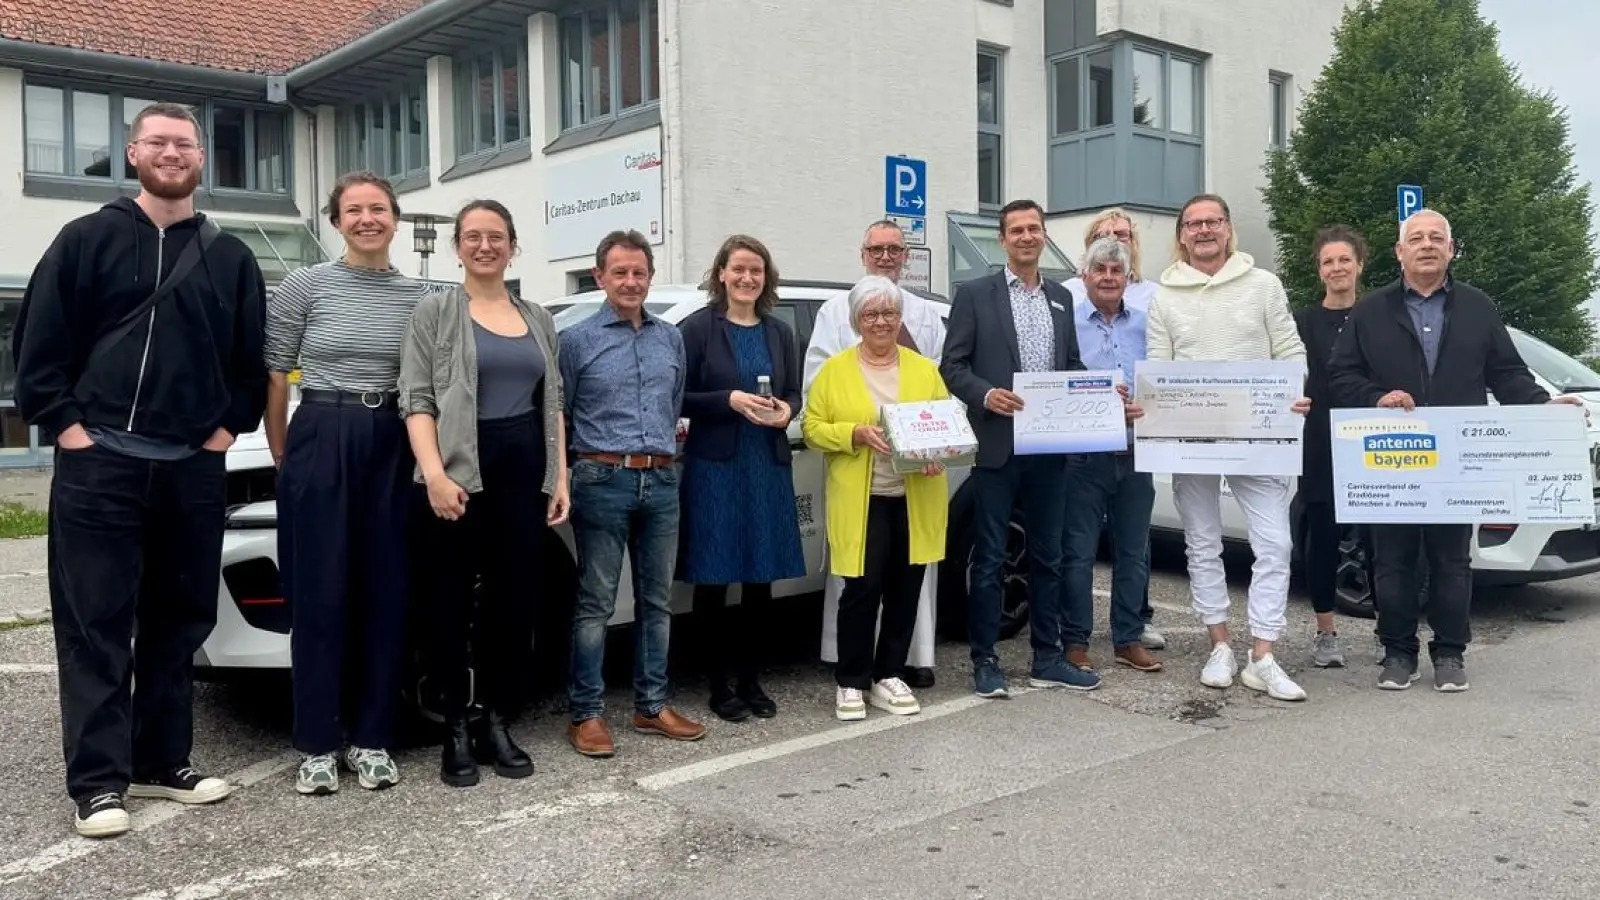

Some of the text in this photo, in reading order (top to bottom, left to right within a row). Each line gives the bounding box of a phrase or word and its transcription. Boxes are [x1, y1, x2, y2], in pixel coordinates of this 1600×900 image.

[624, 152, 657, 169] Caritas
[895, 164, 917, 207] P
[550, 190, 641, 218] Caritas-Zentrum Dachau
[1404, 190, 1416, 217] P
[1461, 427, 1511, 437] € 21.000,-
[1368, 437, 1432, 449] antenne
[1374, 453, 1429, 468] bayern
[1562, 473, 1582, 481] 2025
[1348, 499, 1383, 507] München
[1394, 500, 1427, 508] Freising
[1481, 507, 1510, 515] Dachau
